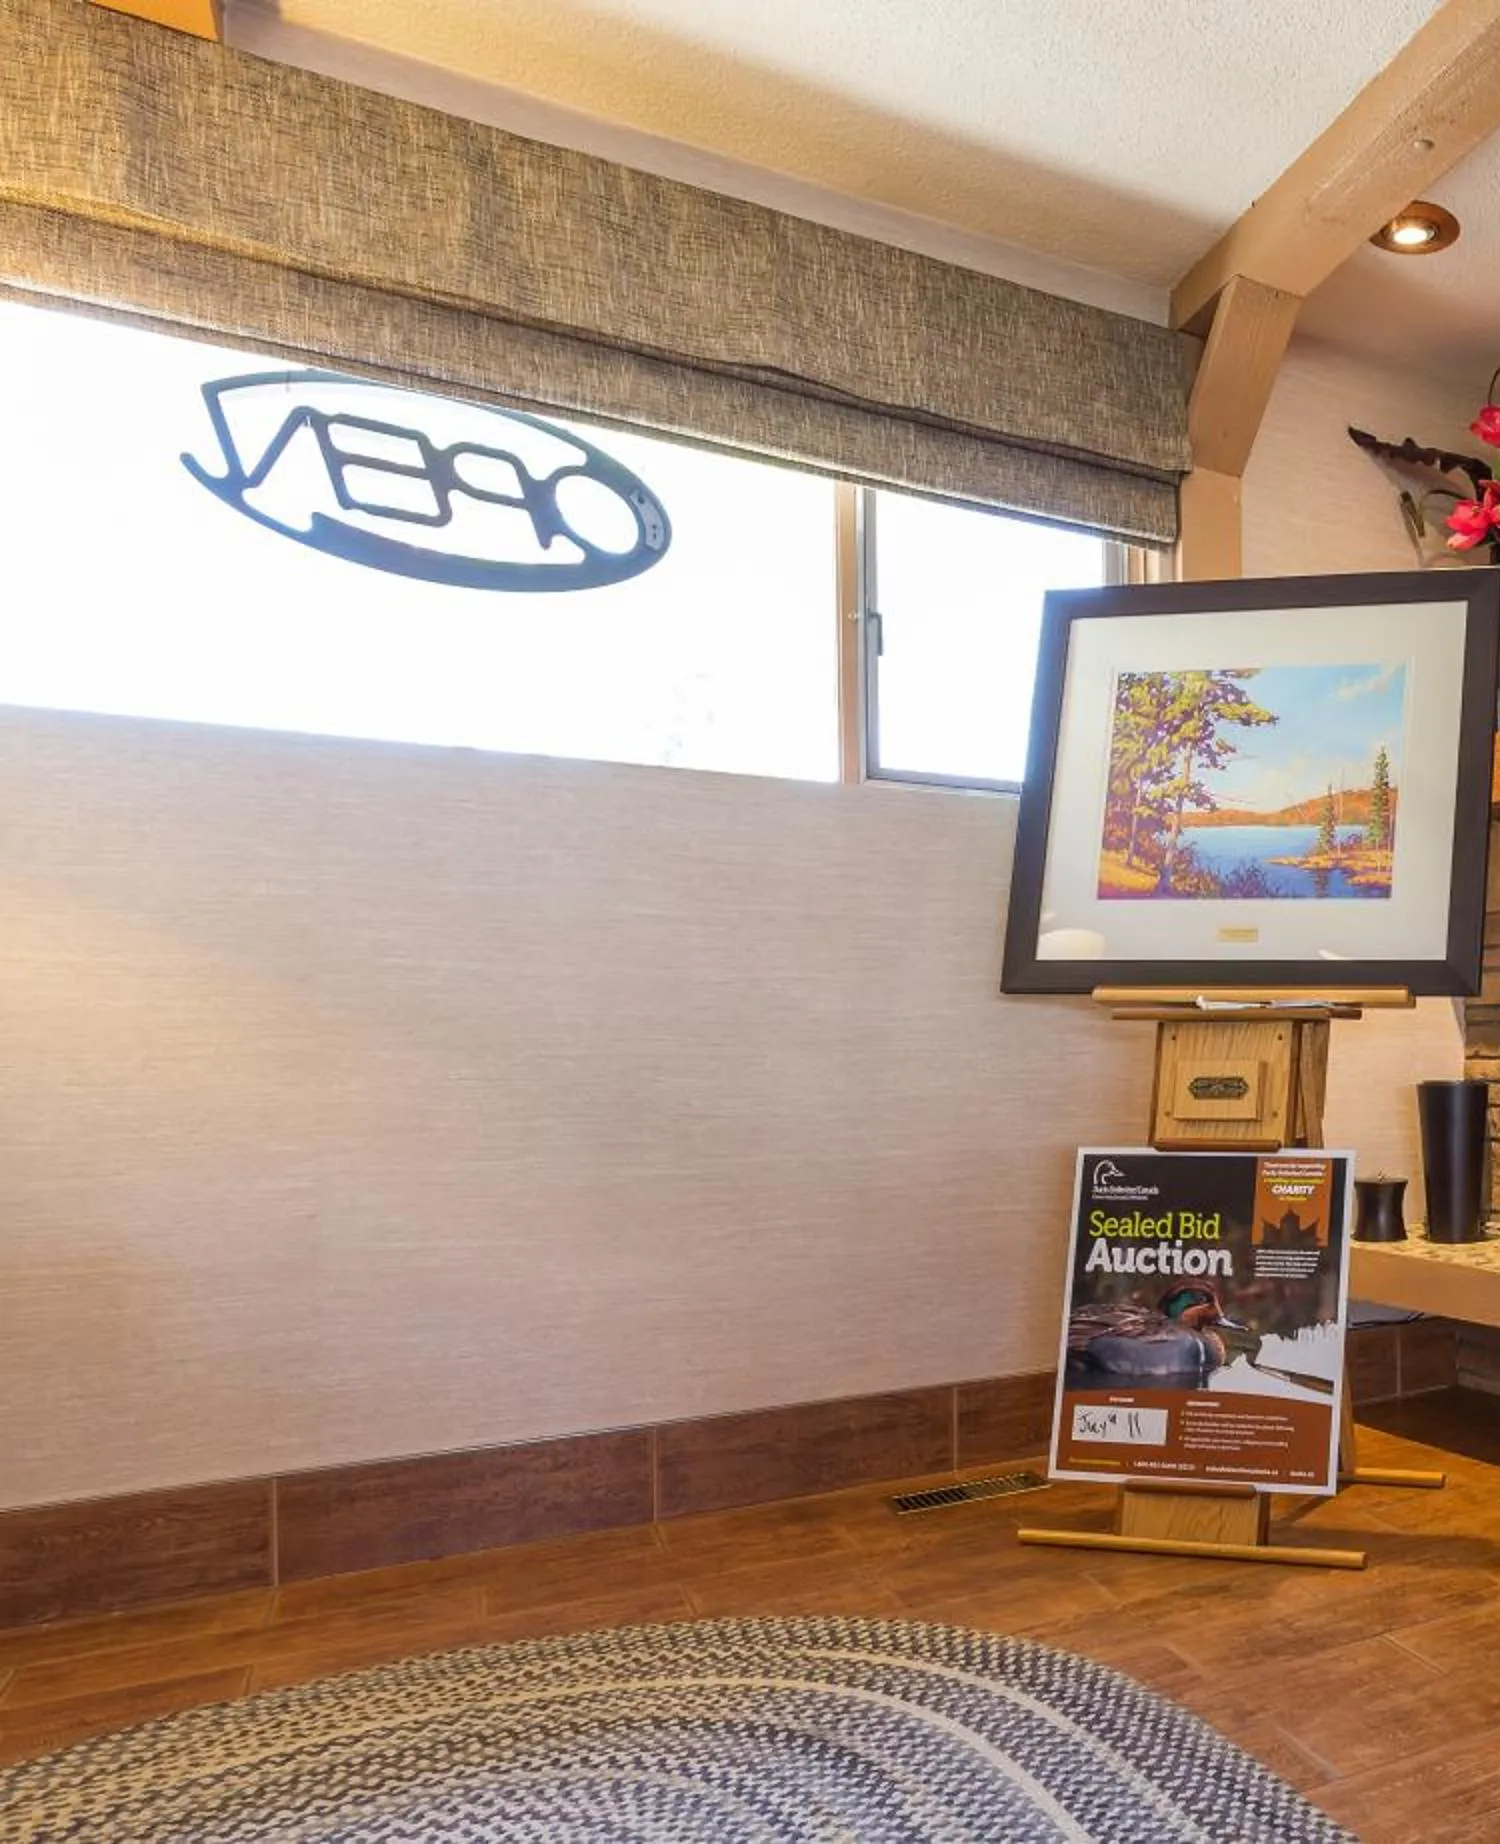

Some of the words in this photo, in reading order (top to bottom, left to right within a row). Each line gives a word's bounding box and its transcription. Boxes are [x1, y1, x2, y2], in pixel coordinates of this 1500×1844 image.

[1089, 1210, 1173, 1238] Sealed
[1179, 1211, 1221, 1239] Bid
[1085, 1237, 1233, 1276] Auction
